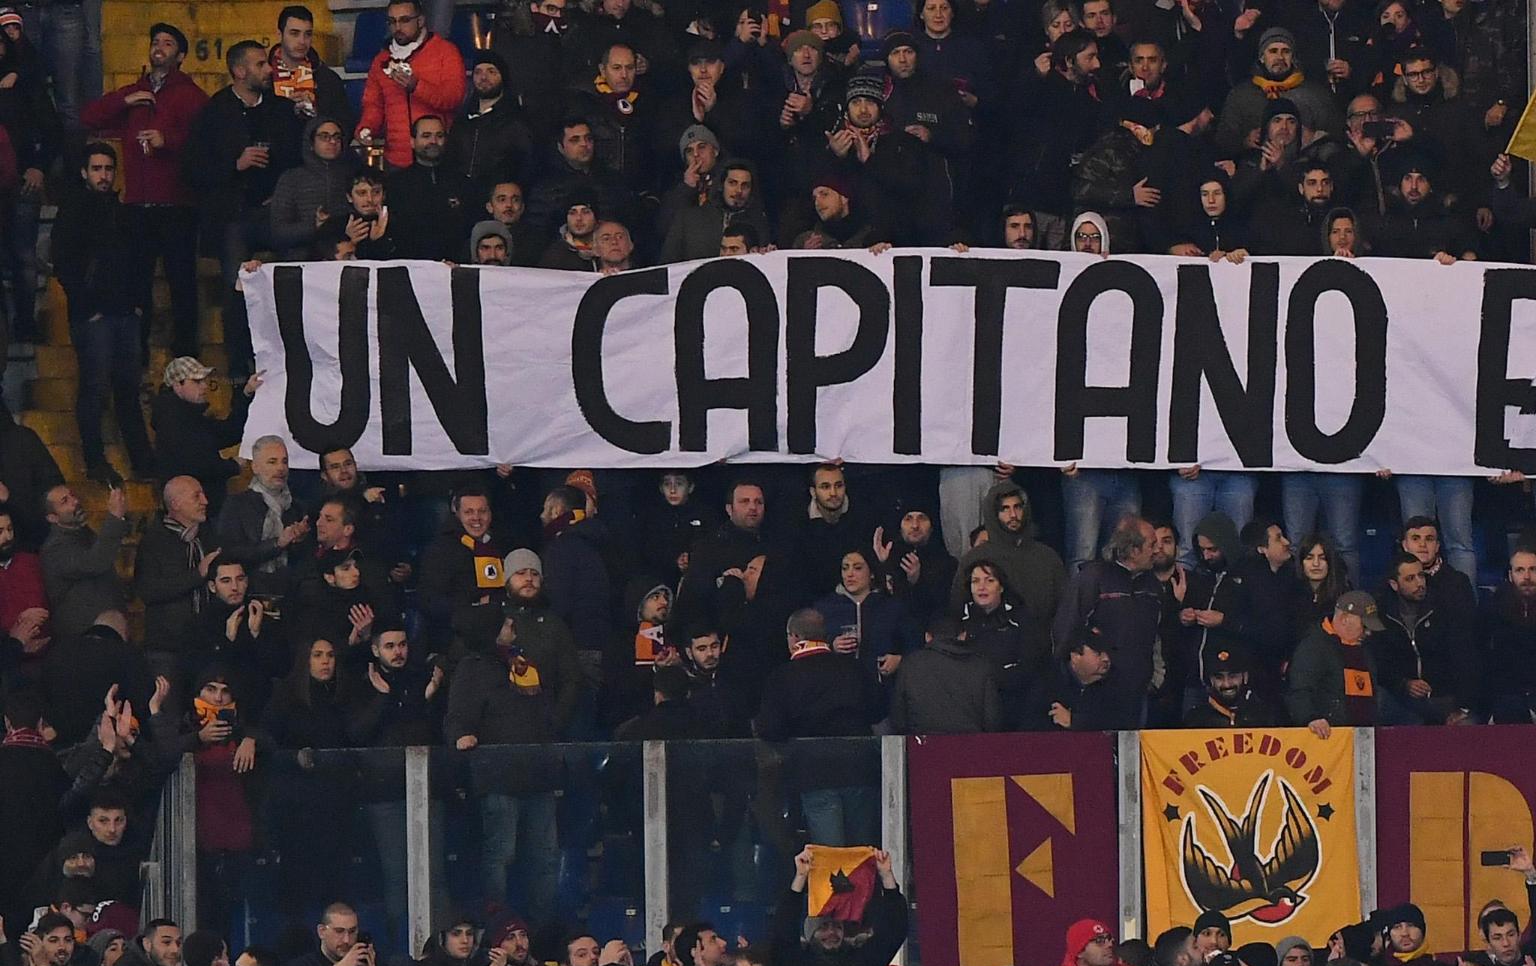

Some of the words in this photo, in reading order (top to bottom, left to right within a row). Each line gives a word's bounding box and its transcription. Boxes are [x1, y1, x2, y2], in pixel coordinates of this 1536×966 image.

[273, 265, 489, 456] UN
[571, 254, 1389, 469] CAPITANO
[1161, 732, 1333, 797] FREEDOM
